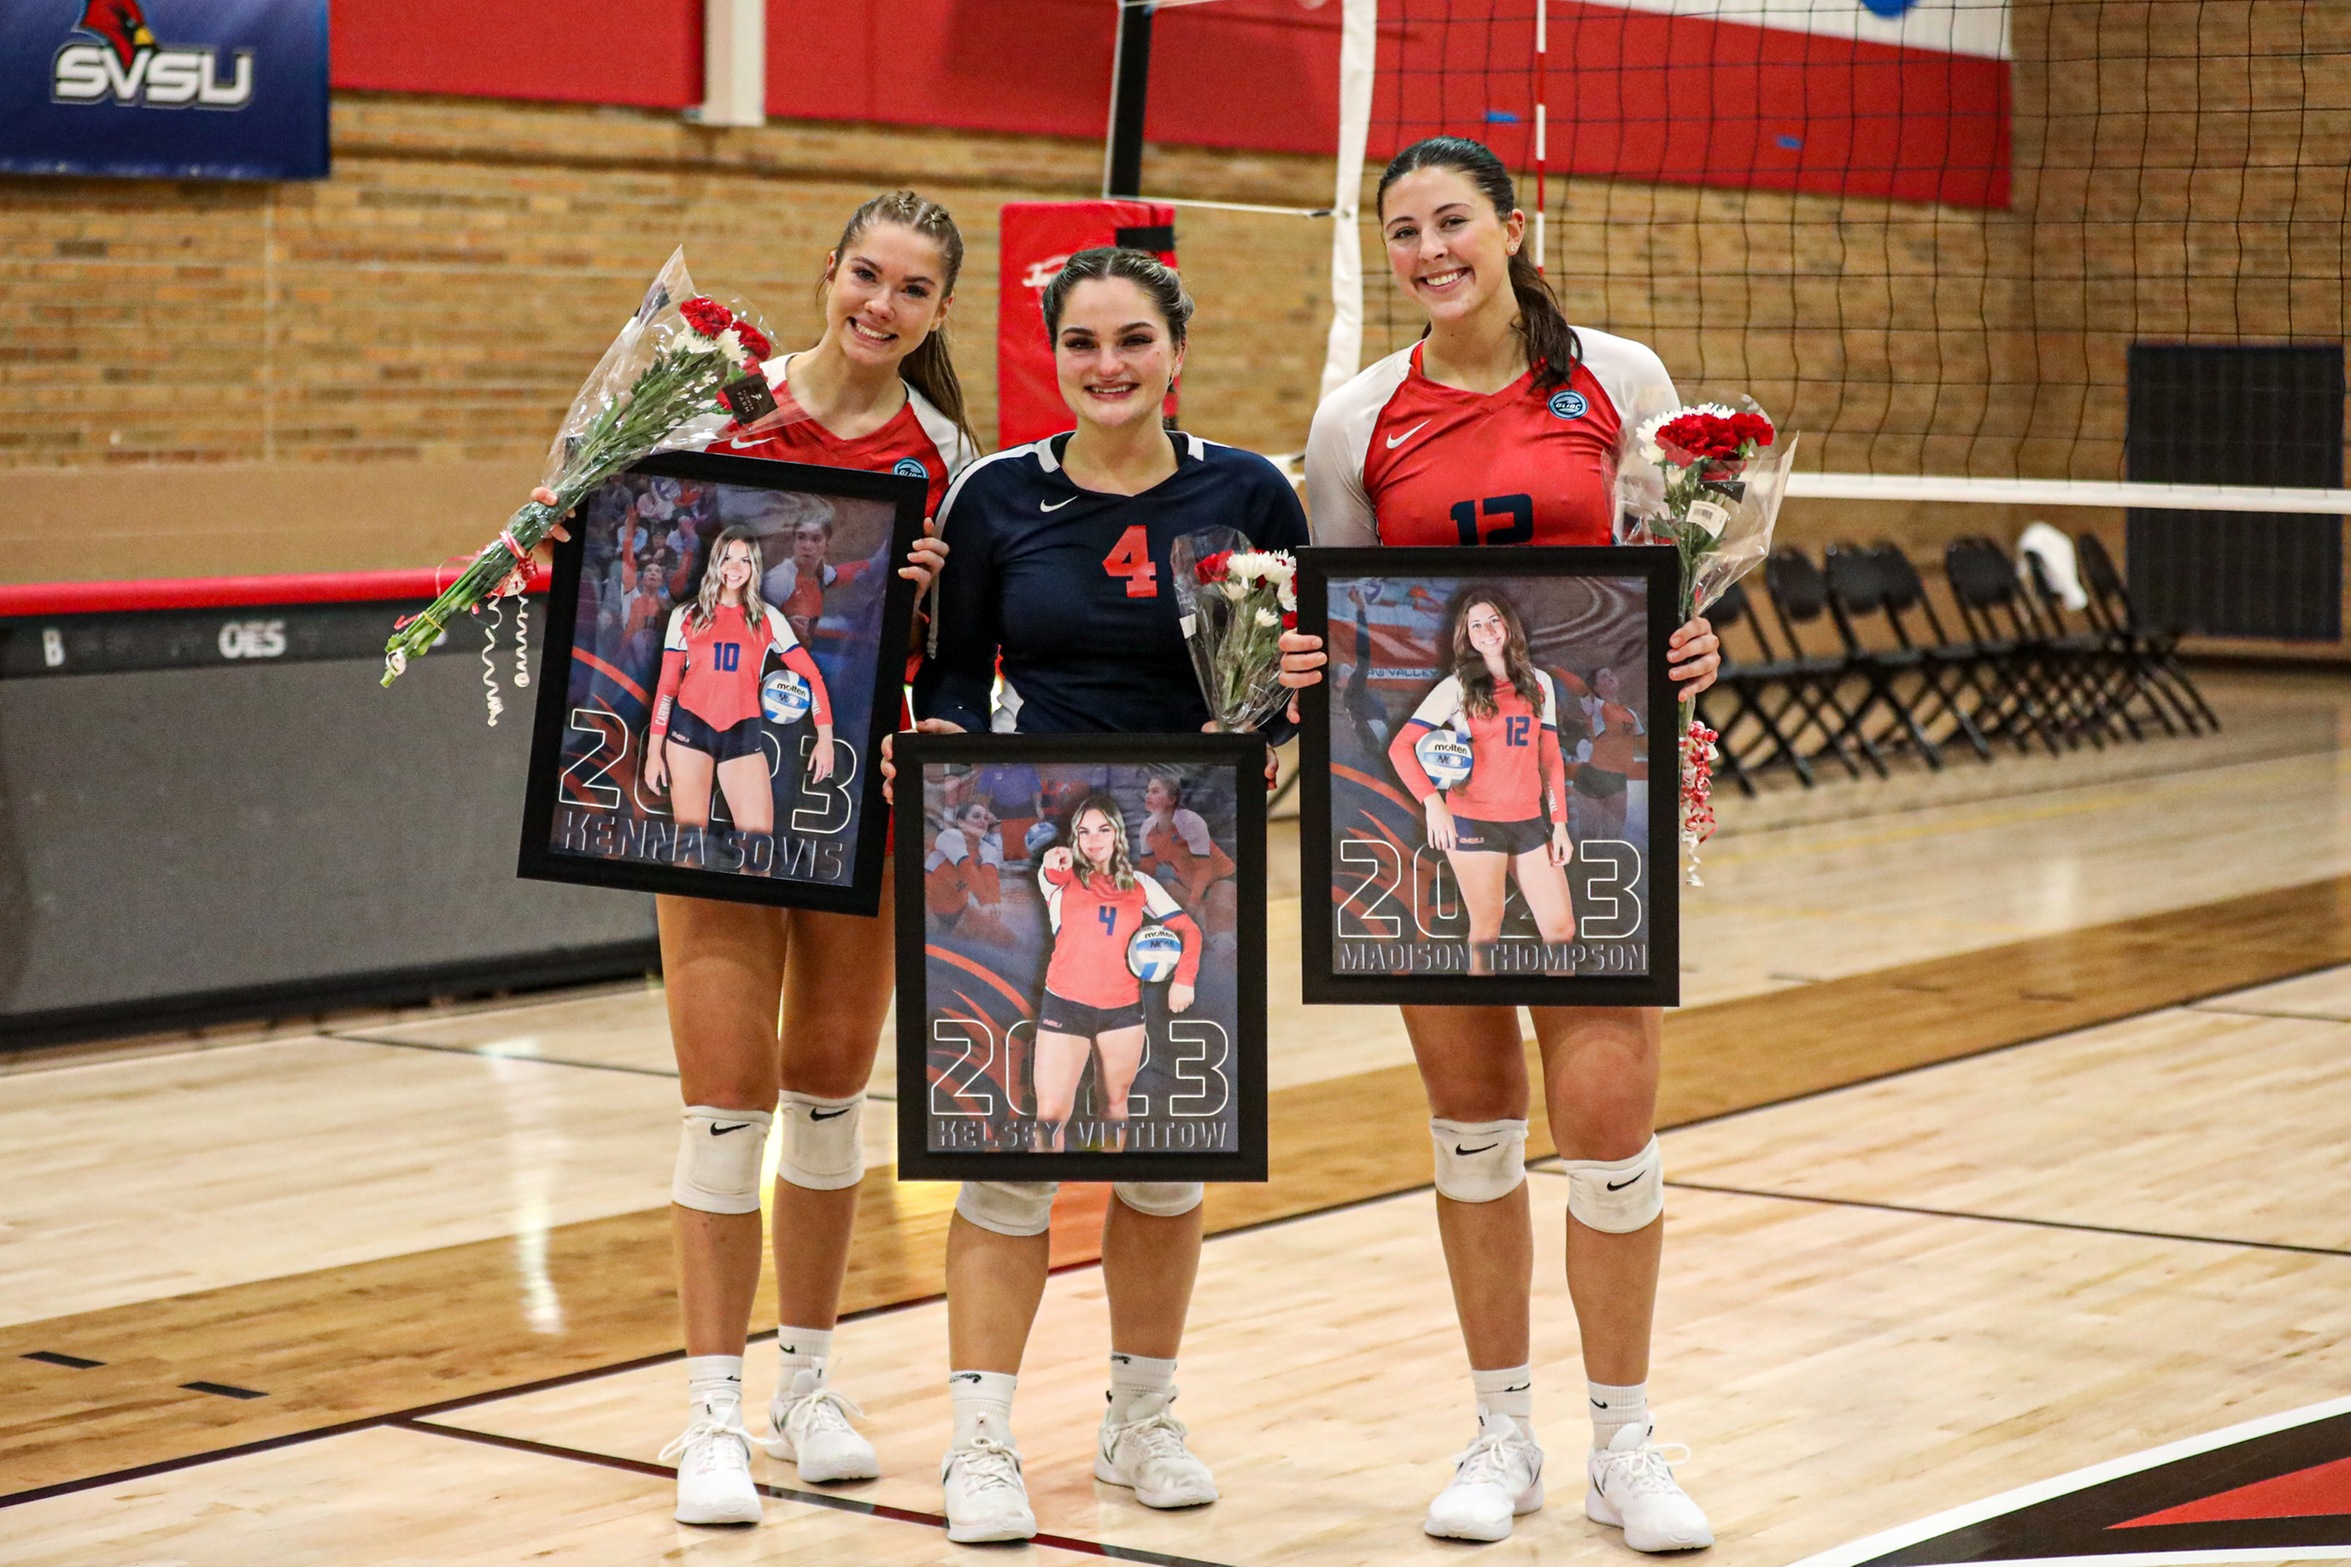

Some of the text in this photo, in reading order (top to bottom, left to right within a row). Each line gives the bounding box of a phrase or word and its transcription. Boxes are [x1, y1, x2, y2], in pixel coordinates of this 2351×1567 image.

[55, 45, 252, 106] SVSU
[1102, 524, 1158, 598] 4
[713, 642, 740, 672] 10
[776, 682, 807, 698] molten
[1505, 715, 1531, 747] 12
[1434, 744, 1468, 756] molten
[564, 811, 844, 881] KENNA SOVIS
[1098, 905, 1117, 936] 4
[1339, 943, 1647, 971] MADISON THOMPSON
[938, 1120, 1227, 1148] KELSEY VITTITOW
